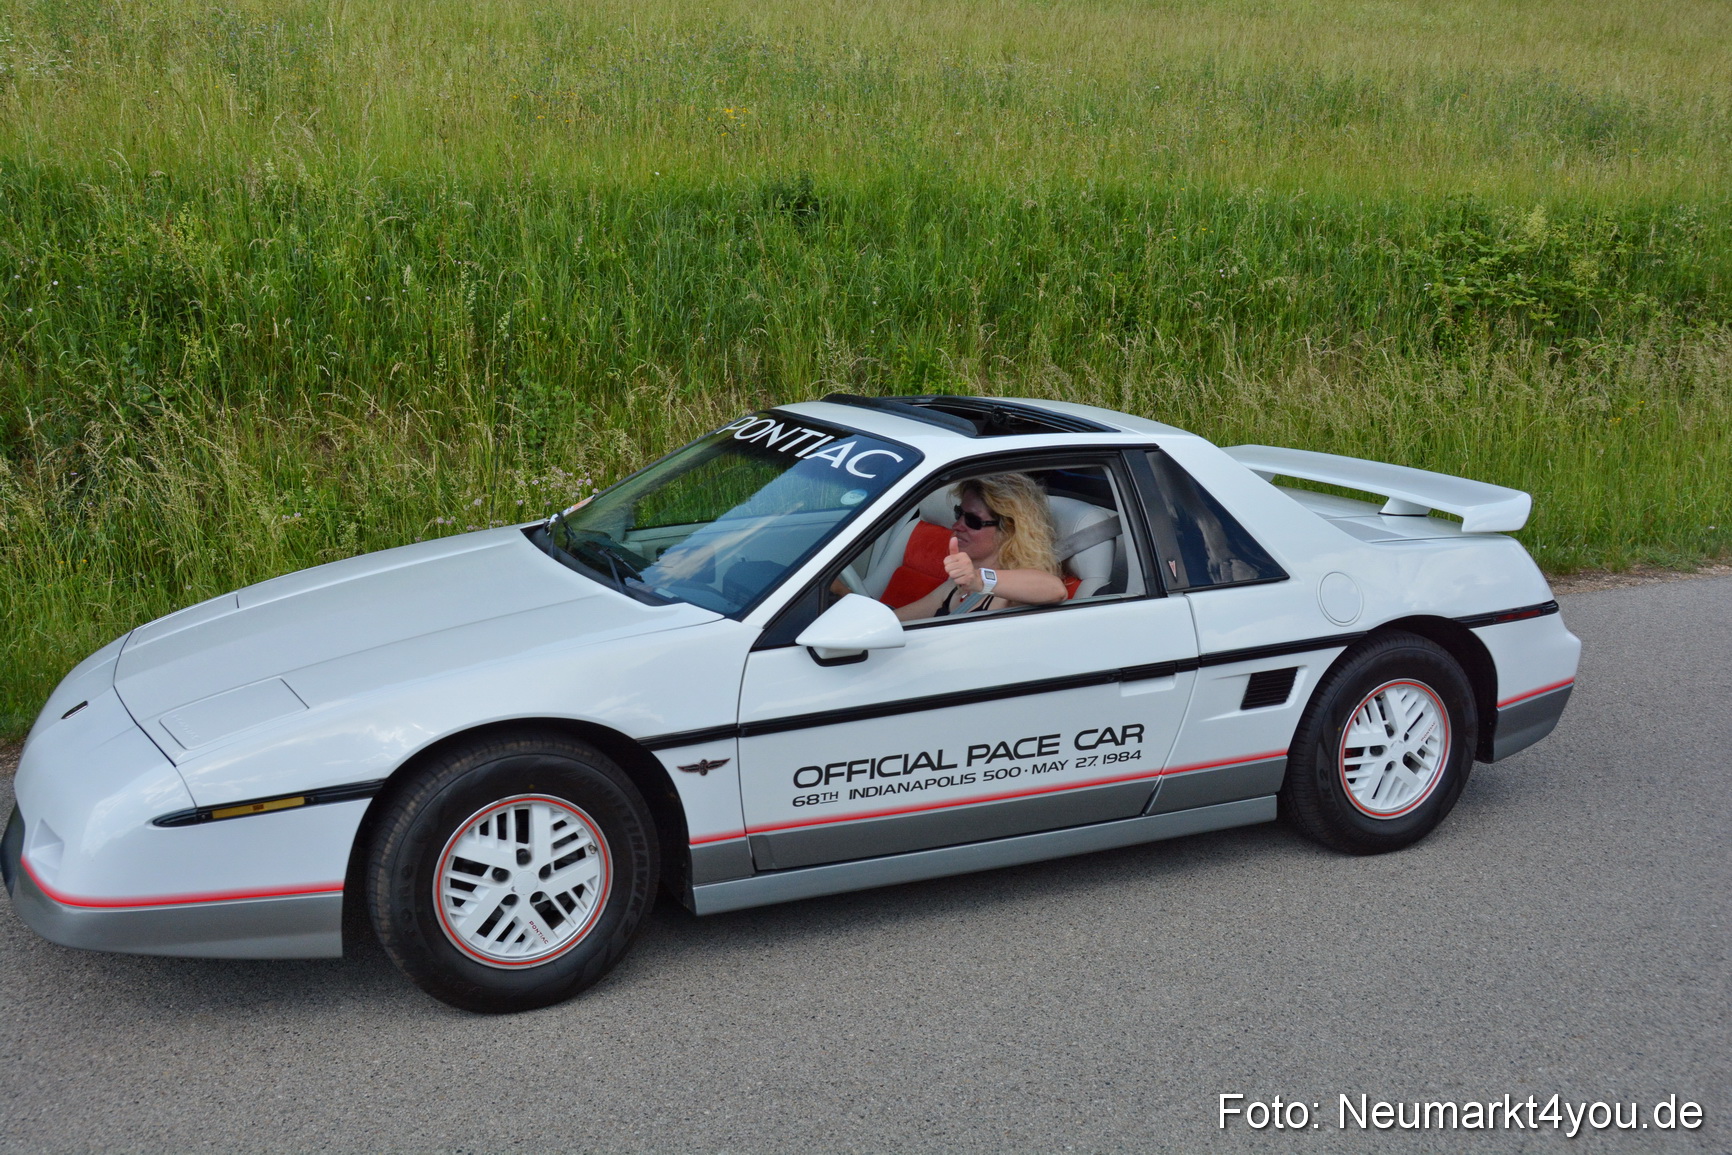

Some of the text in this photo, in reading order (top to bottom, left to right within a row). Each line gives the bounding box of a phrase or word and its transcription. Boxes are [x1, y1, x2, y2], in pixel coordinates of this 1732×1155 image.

[716, 416, 904, 479] PONTIAC
[792, 791, 839, 807] 68TH
[849, 772, 976, 800] INDIANAPOLIS
[983, 766, 1021, 782] 500
[1031, 759, 1069, 775] MAY
[1102, 749, 1142, 765] 1984
[793, 723, 1145, 789] OFFICIAL PACE CAR
[528, 920, 549, 945] PONTIAC
